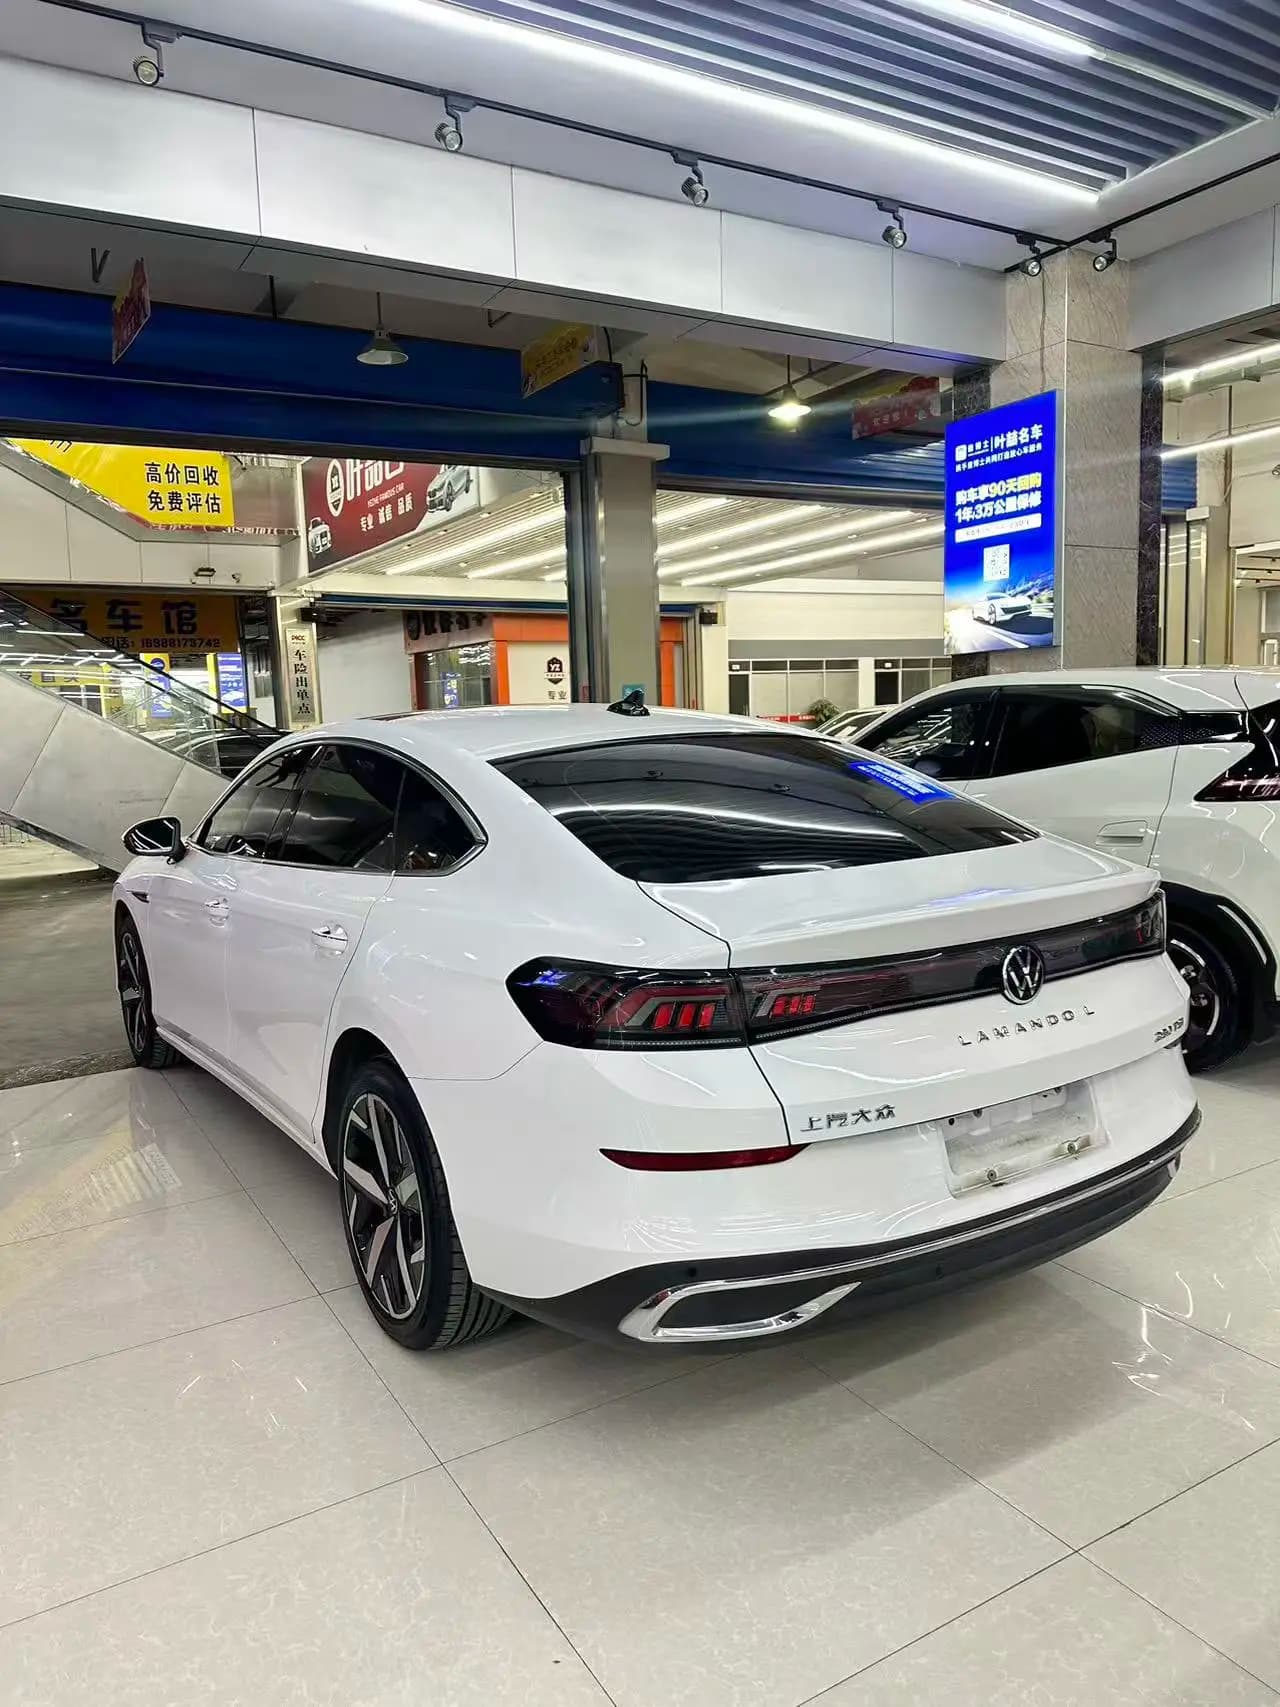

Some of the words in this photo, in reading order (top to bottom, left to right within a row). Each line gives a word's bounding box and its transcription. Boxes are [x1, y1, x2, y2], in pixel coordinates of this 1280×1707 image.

[144, 461, 219, 486] 高价回收
[147, 489, 221, 514] 免费评估
[397, 492, 413, 515] 品质
[293, 648, 312, 714] 车险出单点
[958, 1010, 1075, 1046] LAMANDO
[1083, 1006, 1095, 1016] L
[800, 1104, 896, 1132] 上汽大众
